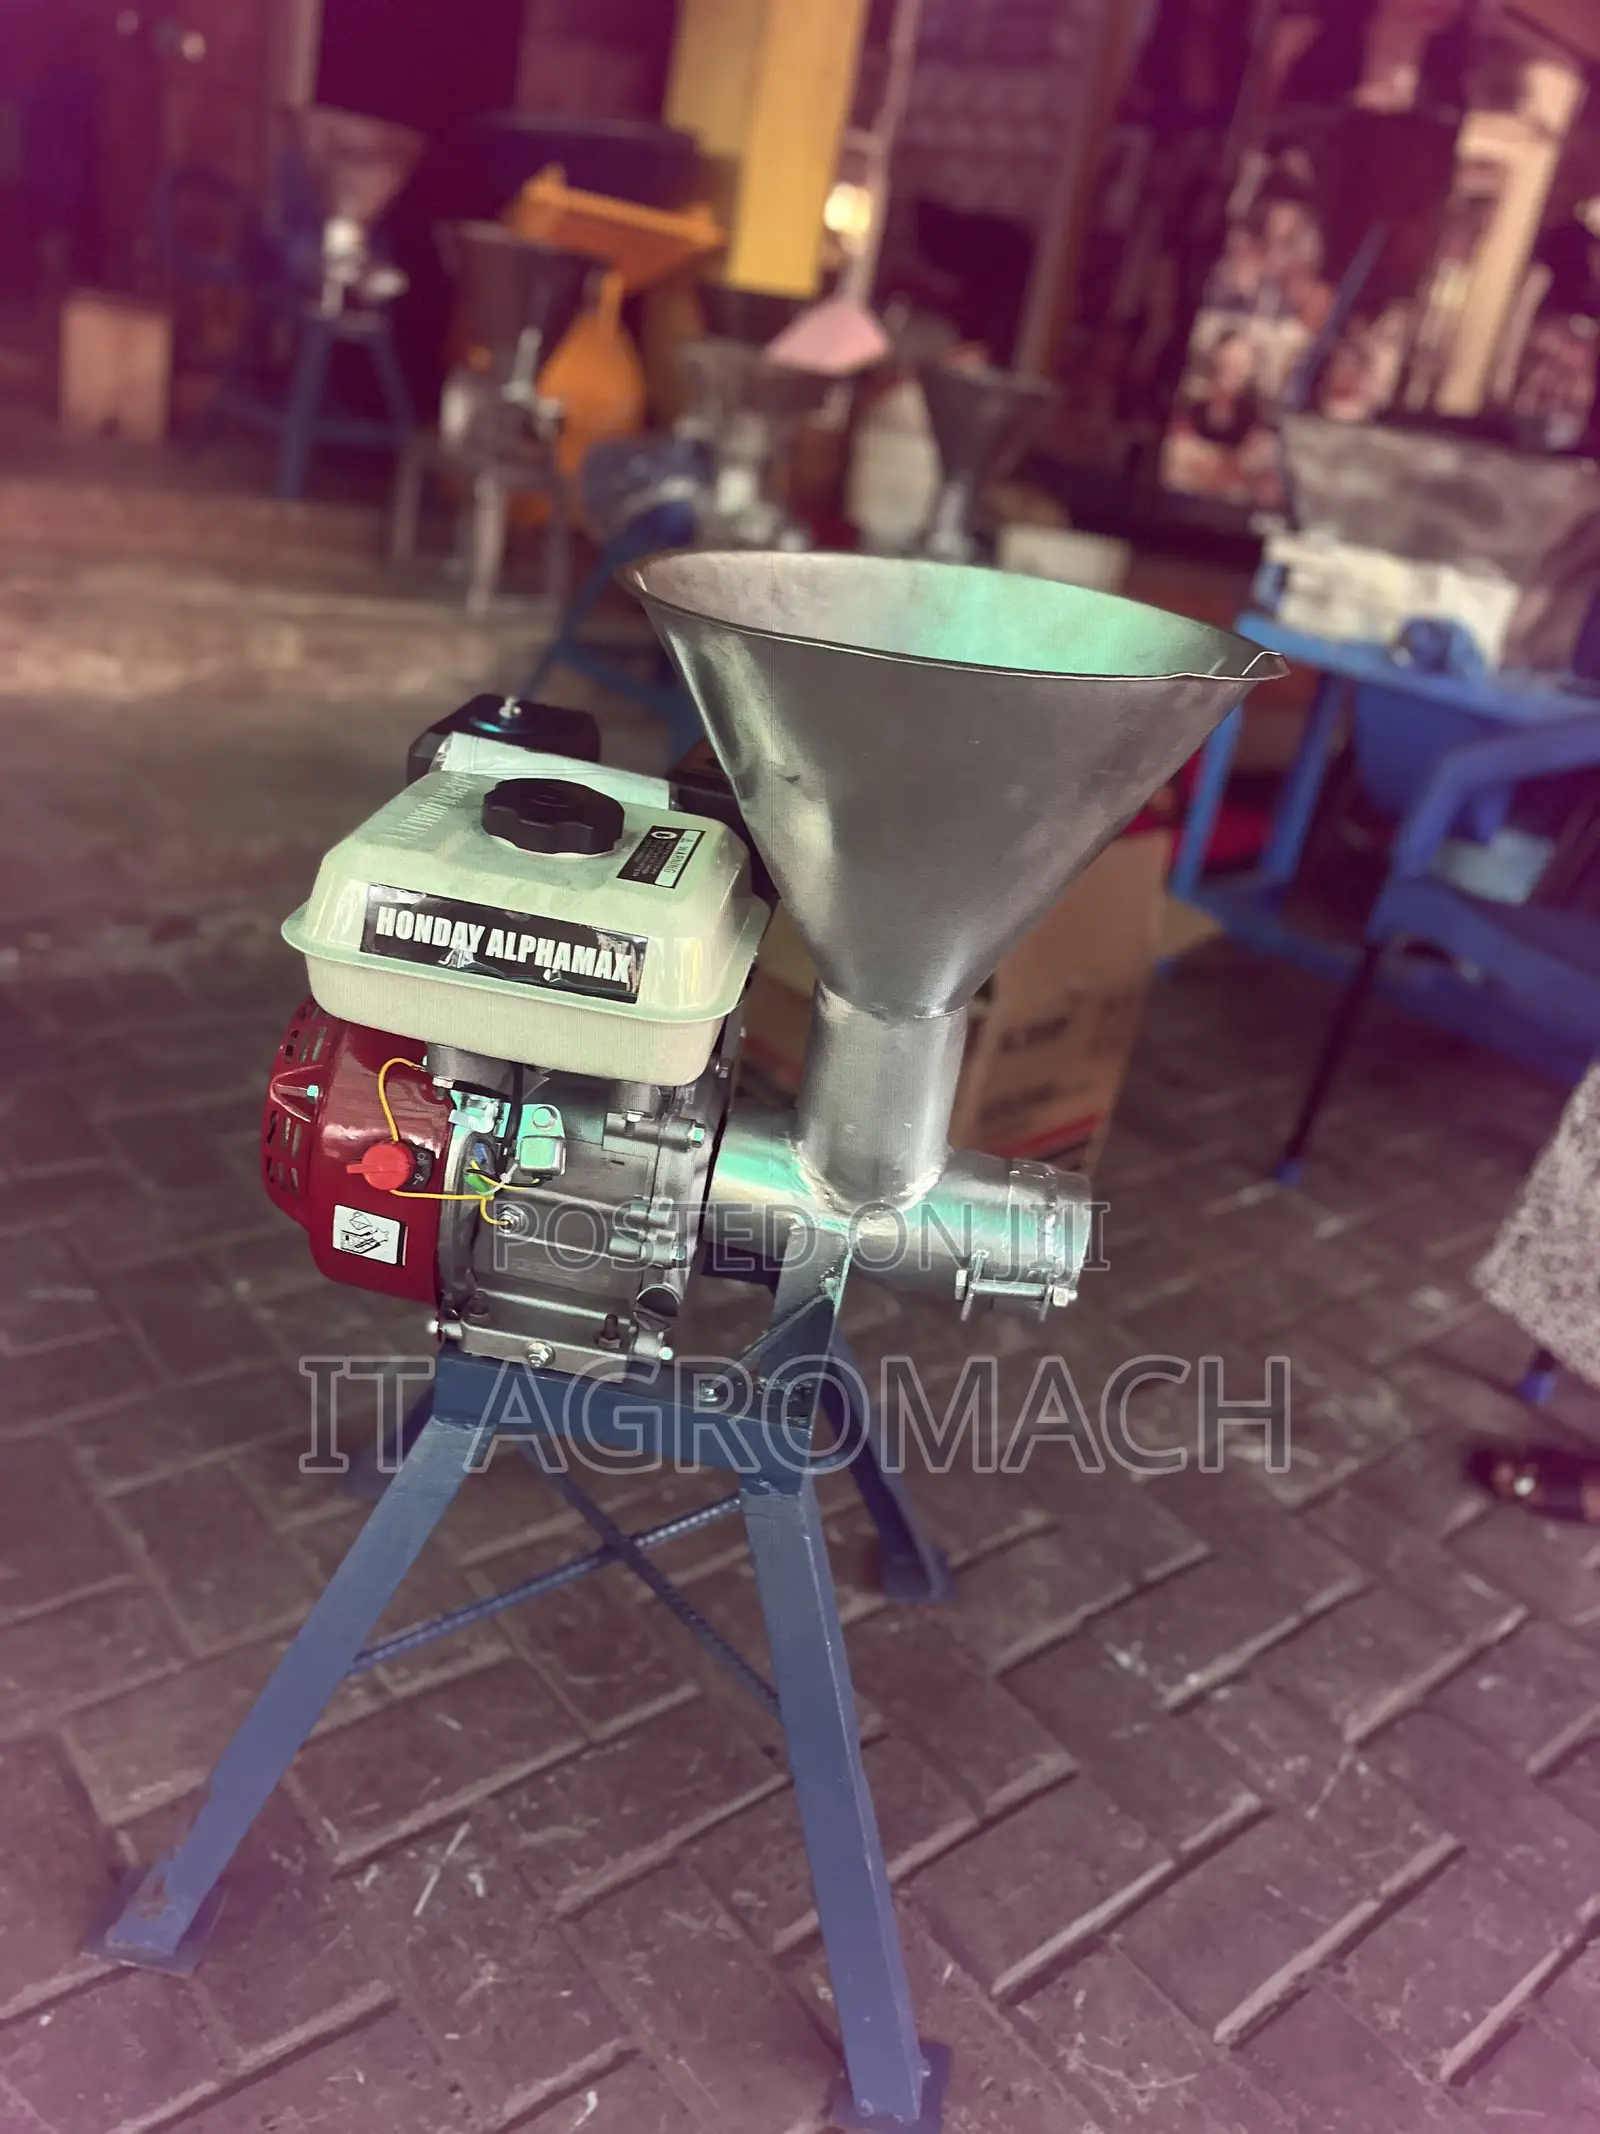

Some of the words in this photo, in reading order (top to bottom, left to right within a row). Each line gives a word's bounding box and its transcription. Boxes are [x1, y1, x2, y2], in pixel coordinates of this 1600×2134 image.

[663, 845, 689, 874] WARNING
[376, 906, 485, 953] HONDAY
[485, 928, 632, 984] ALPHAMAX
